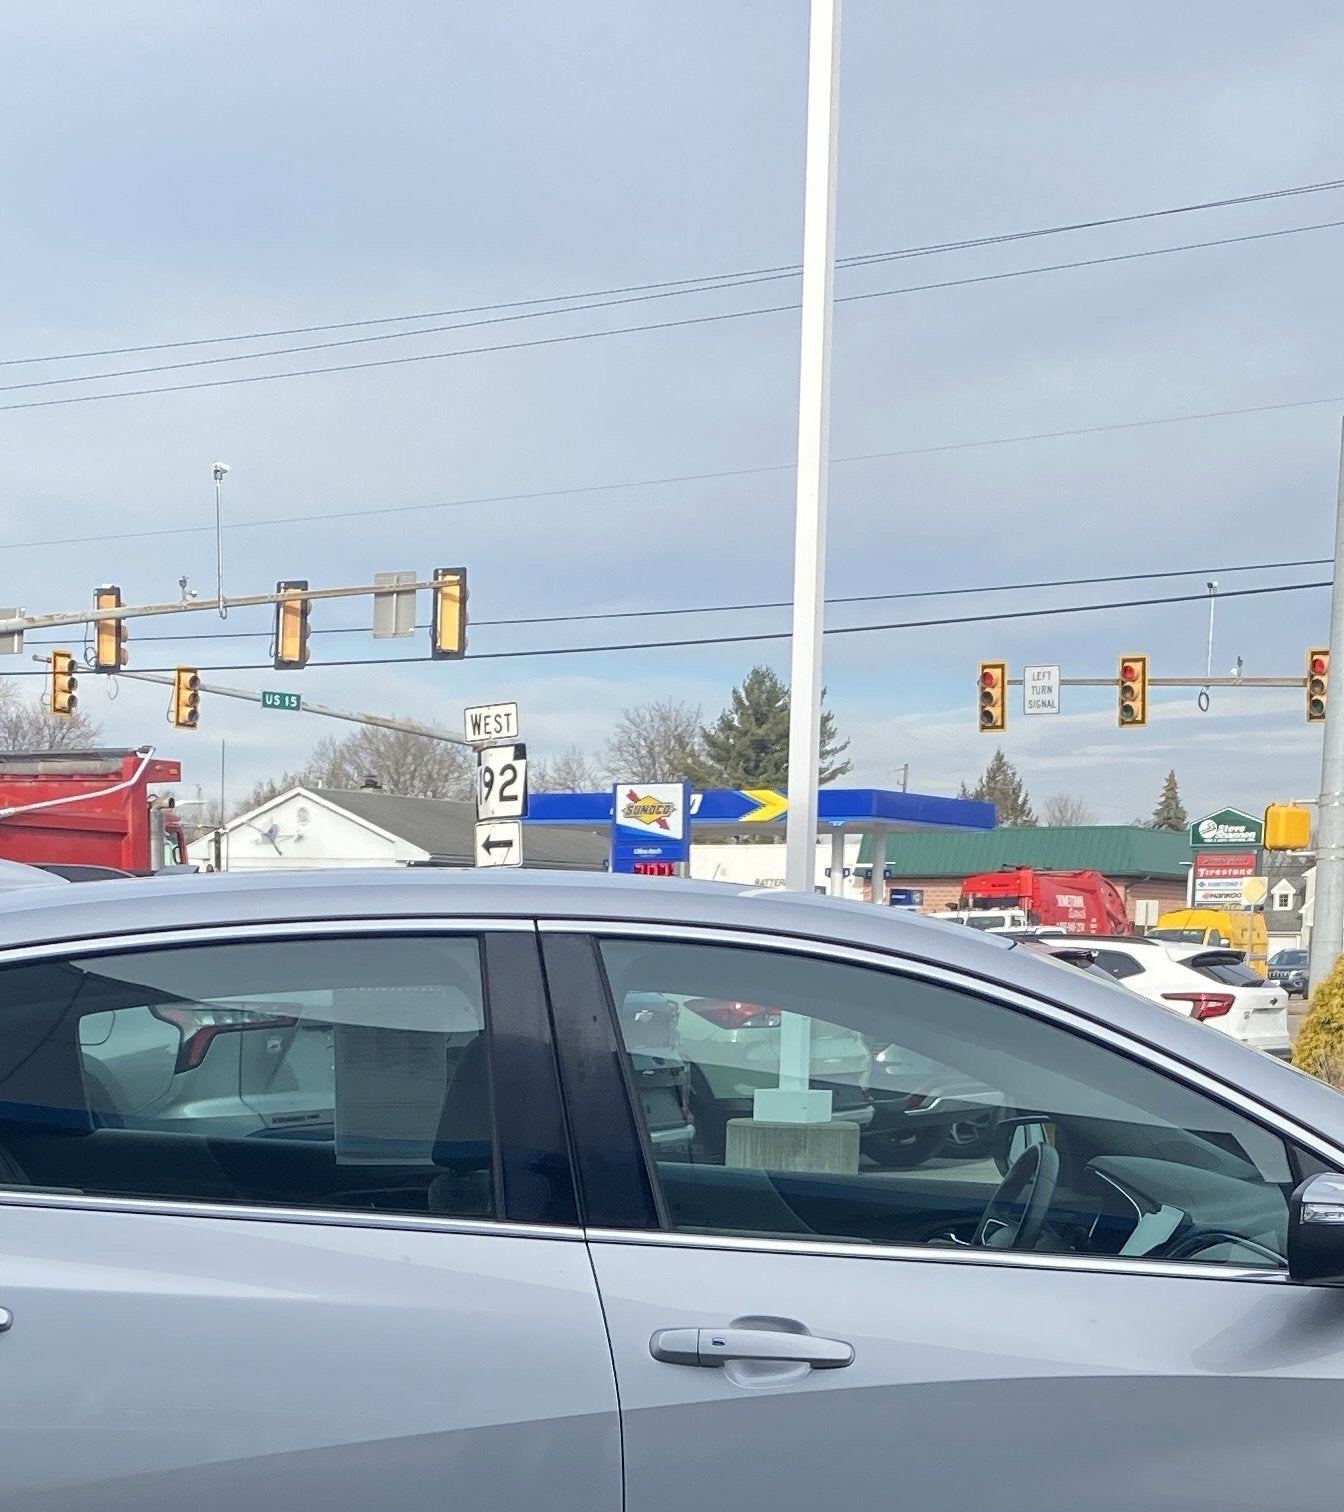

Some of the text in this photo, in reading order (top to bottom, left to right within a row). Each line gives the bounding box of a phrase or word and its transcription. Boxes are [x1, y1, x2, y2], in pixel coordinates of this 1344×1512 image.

[1032, 671, 1051, 681] LEFT
[1031, 685, 1053, 695] TURN
[265, 694, 297, 707] US 15
[1028, 699, 1056, 709] SIGNAL
[470, 713, 512, 736] WEST
[625, 804, 672, 816] SUNOCO
[1198, 868, 1253, 877] Firestone
